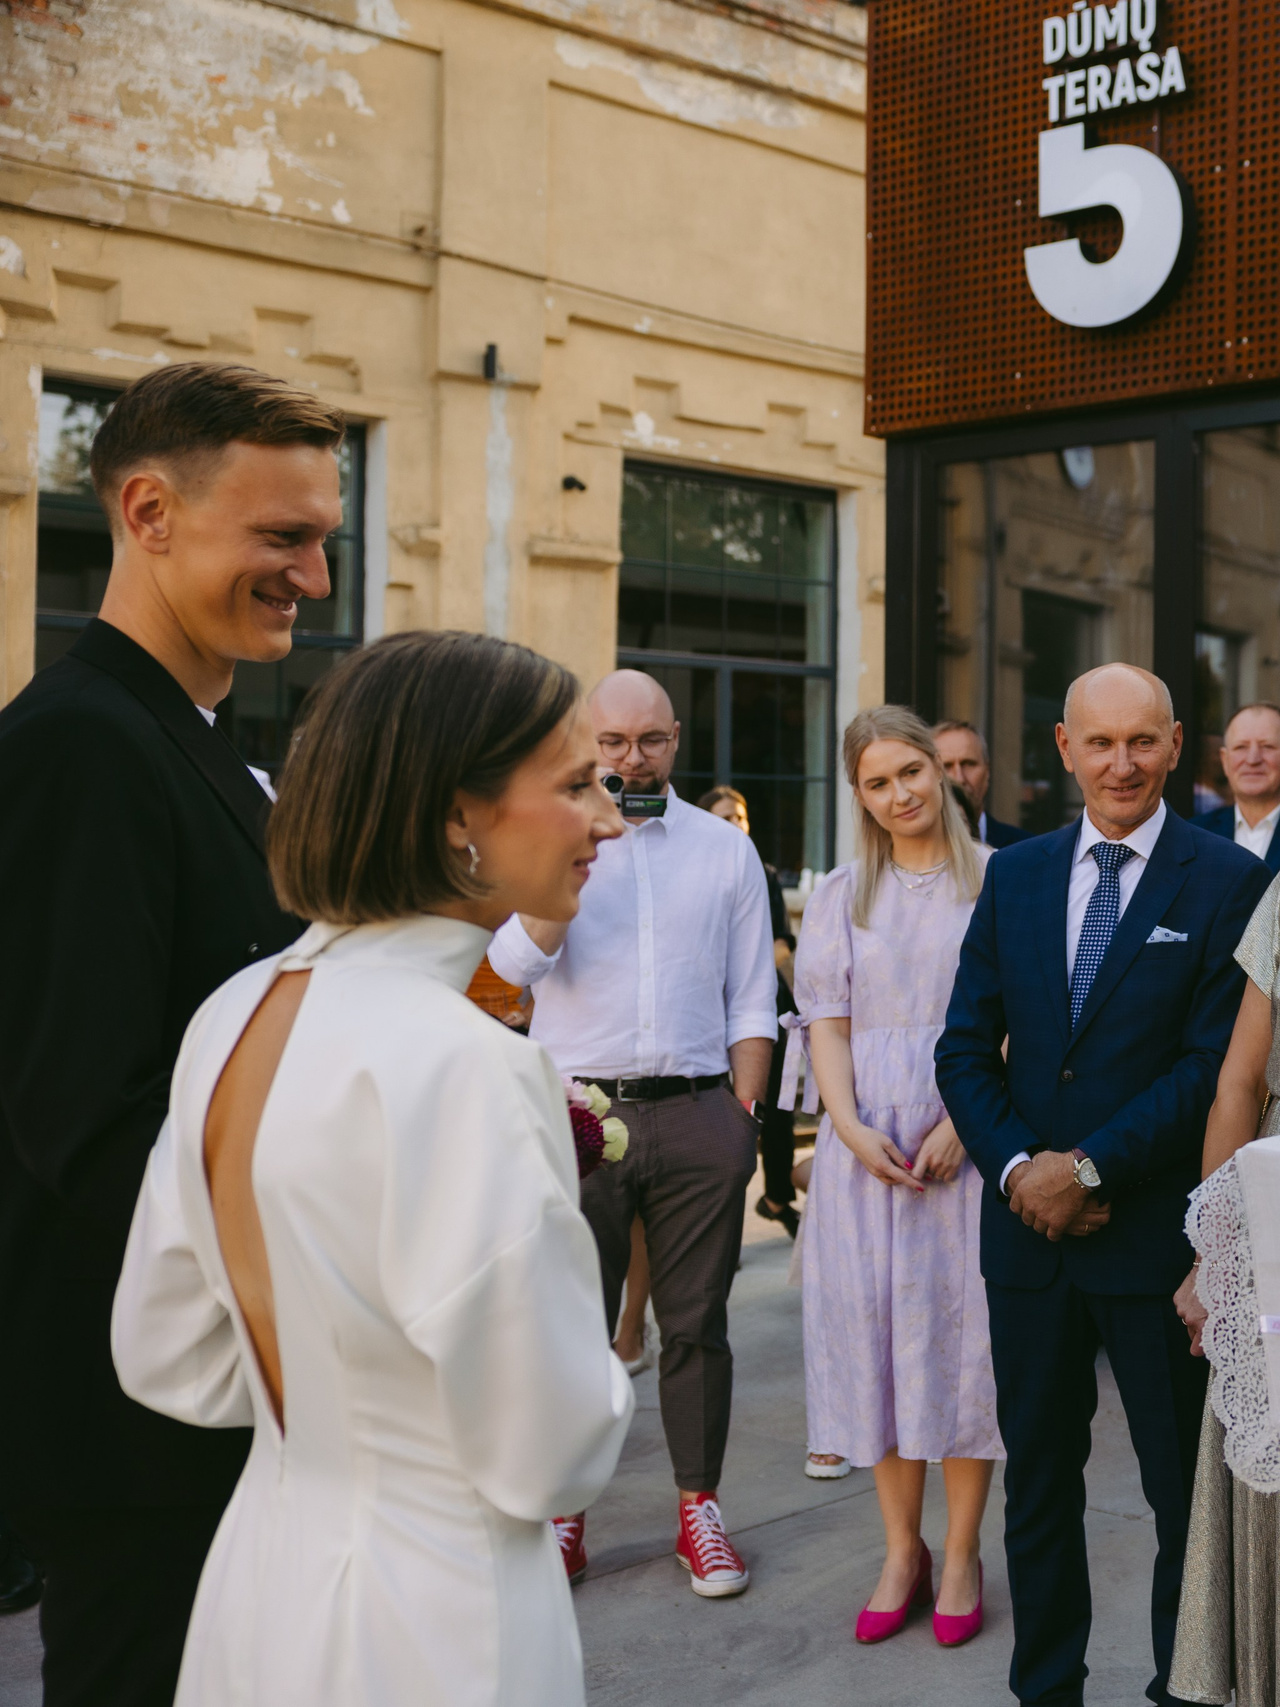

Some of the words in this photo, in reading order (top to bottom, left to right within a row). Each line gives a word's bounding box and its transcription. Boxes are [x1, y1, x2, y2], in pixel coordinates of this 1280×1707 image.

[1043, 0, 1157, 64] DŪMŲ
[1042, 46, 1186, 122] TERASA
[1024, 122, 1183, 328] 5
